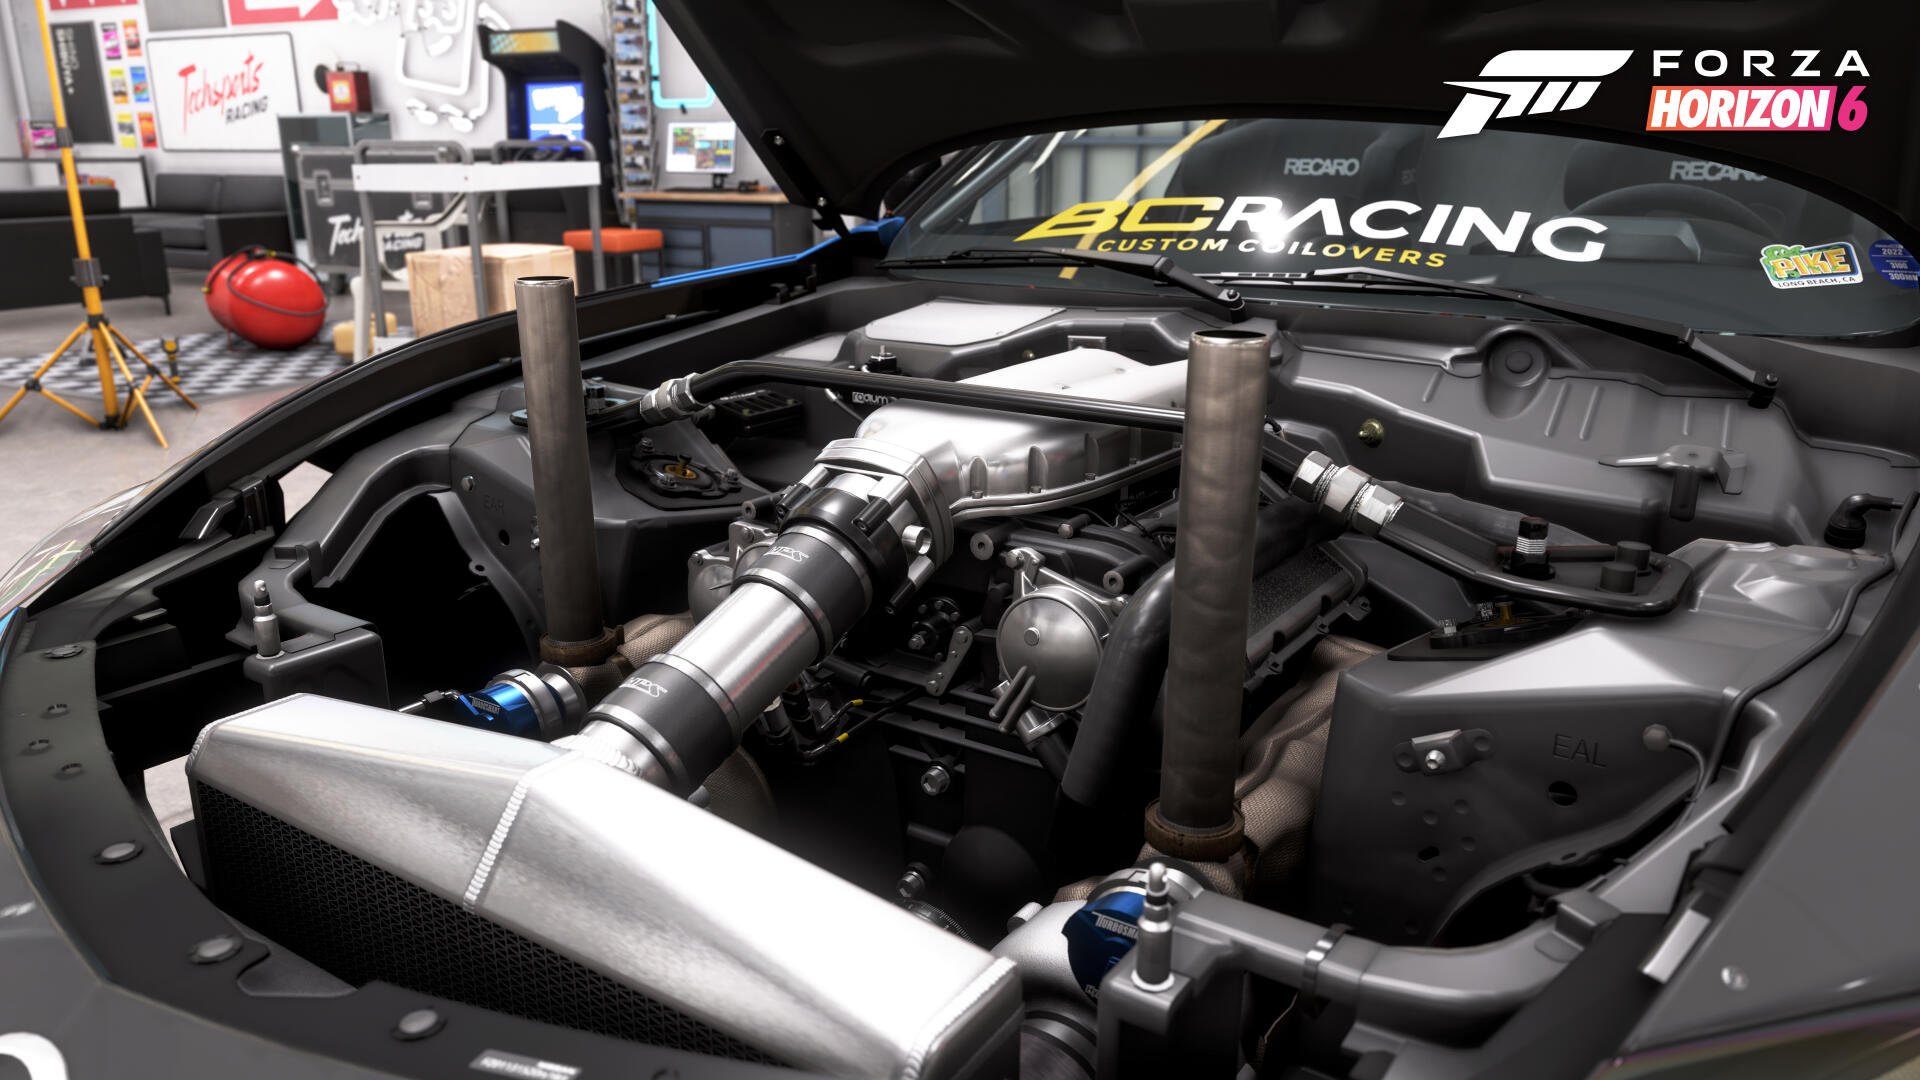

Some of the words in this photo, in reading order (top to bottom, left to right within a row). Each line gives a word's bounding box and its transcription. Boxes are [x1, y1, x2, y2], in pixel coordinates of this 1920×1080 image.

[225, 95, 268, 123] RACING
[1283, 158, 1360, 176] RECARO
[1097, 238, 1229, 252] CUSTOM
[1238, 240, 1447, 268] COILOVERS
[1769, 248, 1851, 278] PIKE
[1778, 279, 1805, 288] LONG
[1553, 733, 1607, 768] EAL
